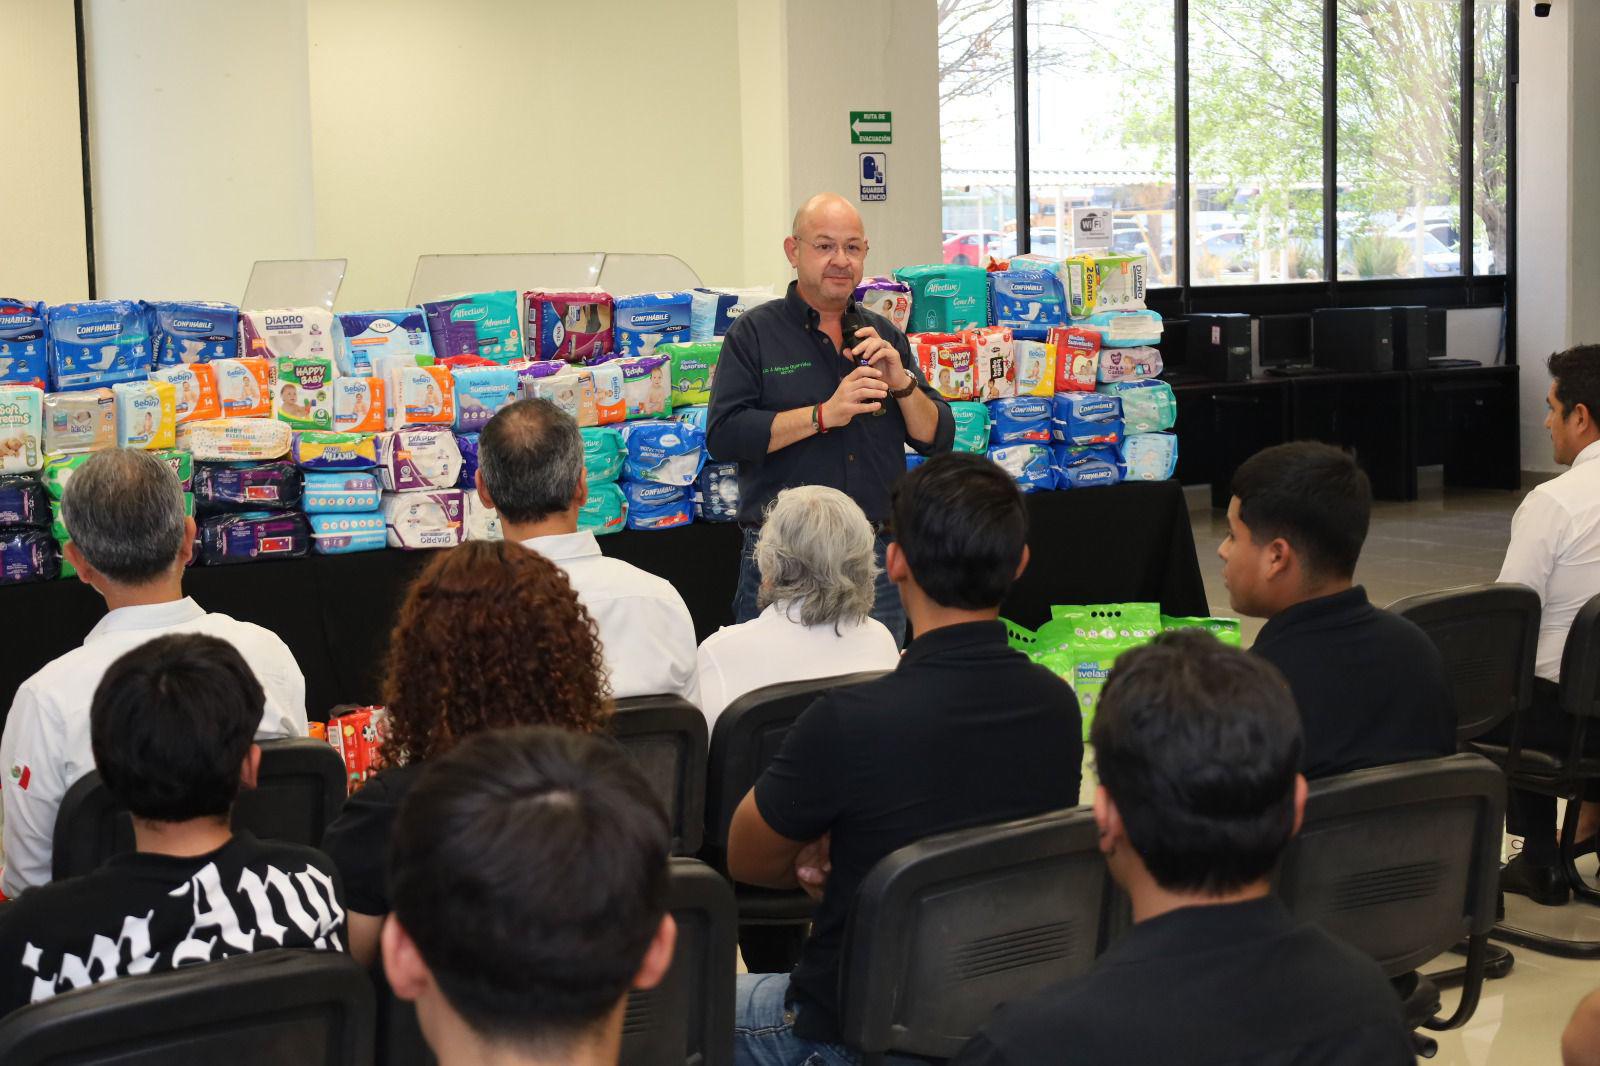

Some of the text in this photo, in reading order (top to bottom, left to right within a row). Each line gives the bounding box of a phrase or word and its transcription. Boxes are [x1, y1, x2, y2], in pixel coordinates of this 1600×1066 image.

[927, 283, 957, 293] Affective
[453, 306, 486, 318] Affective
[265, 315, 303, 325] DIAPRO
[482, 316, 511, 328] Advanced
[950, 351, 971, 361] HAPPY
[295, 366, 326, 376] HAPPY
[300, 375, 324, 385] BABY
[470, 384, 510, 393] Suavelastic
